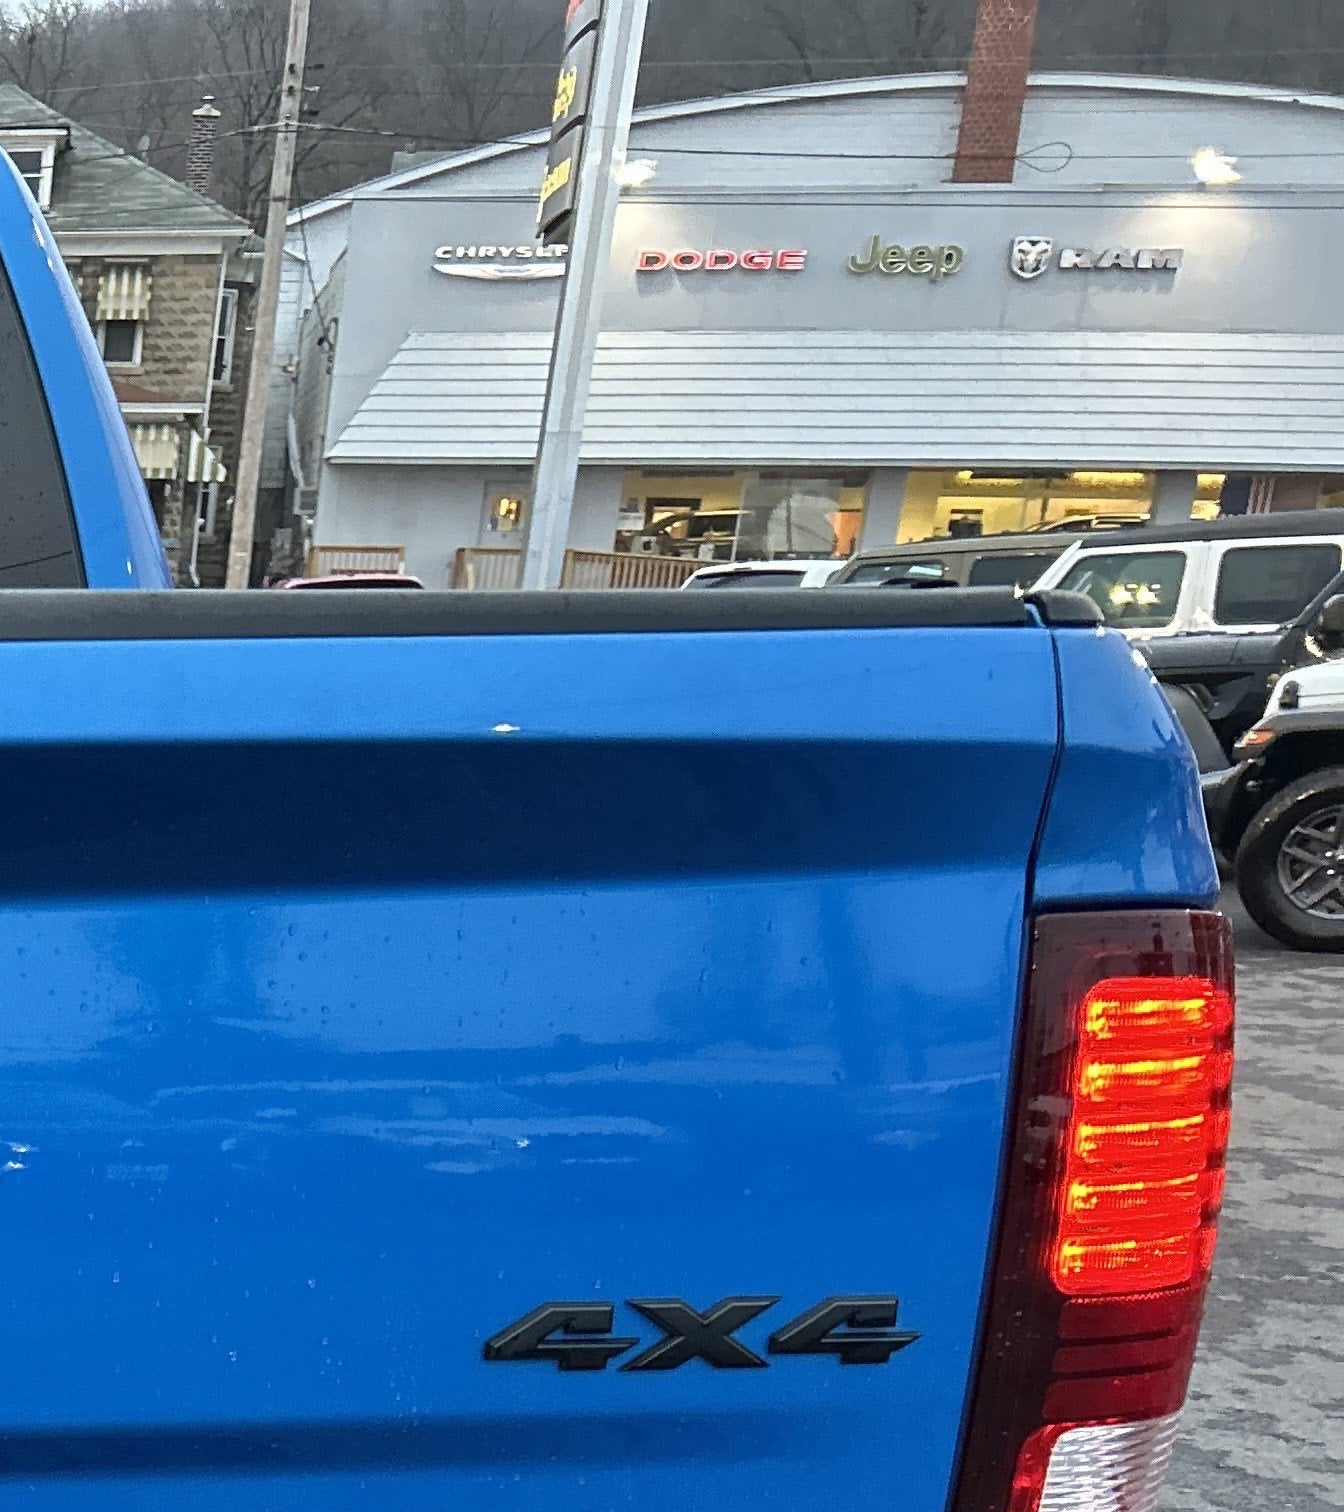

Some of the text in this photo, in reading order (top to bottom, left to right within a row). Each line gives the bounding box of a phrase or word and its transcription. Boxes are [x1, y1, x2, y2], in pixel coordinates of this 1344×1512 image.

[636, 249, 808, 271] DODGE
[848, 234, 963, 280] Jeep
[1059, 248, 1184, 269] RAM
[483, 1296, 921, 1371] 4X4
